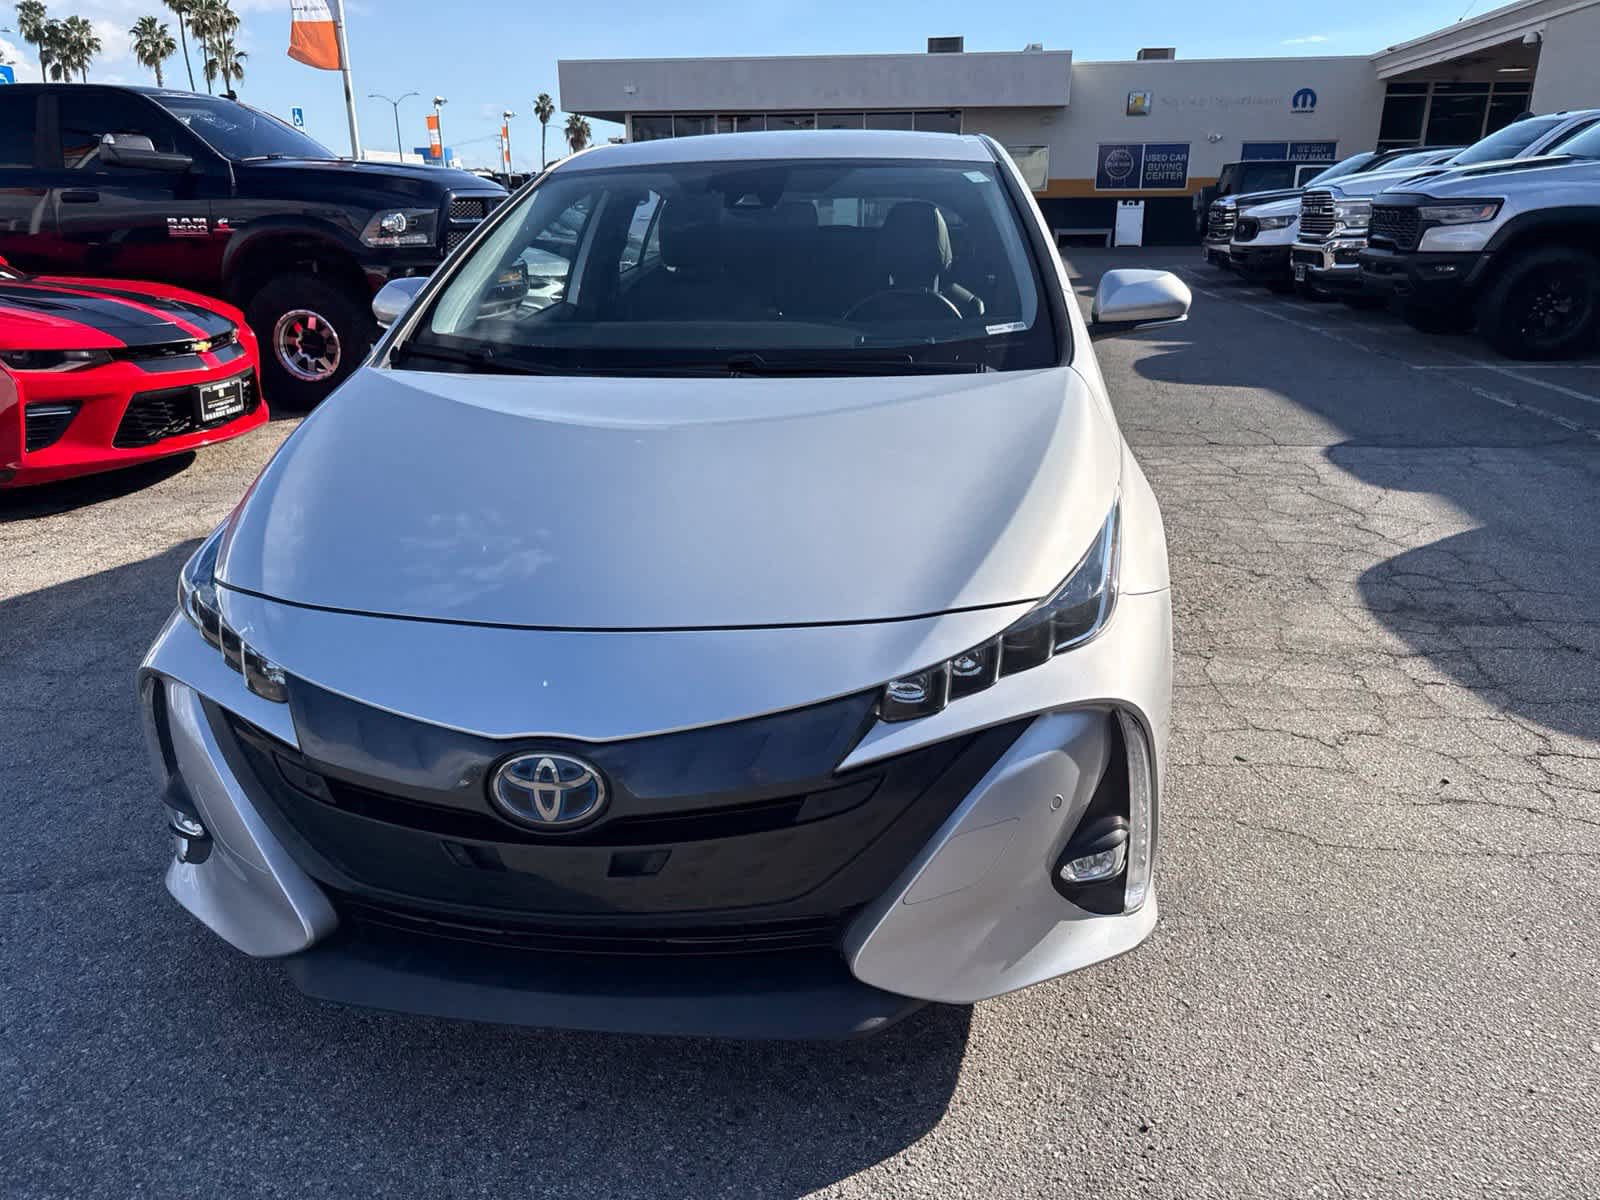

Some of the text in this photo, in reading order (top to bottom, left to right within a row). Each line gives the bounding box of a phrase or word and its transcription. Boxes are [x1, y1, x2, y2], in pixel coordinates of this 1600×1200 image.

[1145, 153, 1187, 162] USED CAR
[1147, 162, 1183, 171] BUYING
[1145, 171, 1183, 181] CENTER
[166, 217, 207, 225] RAM
